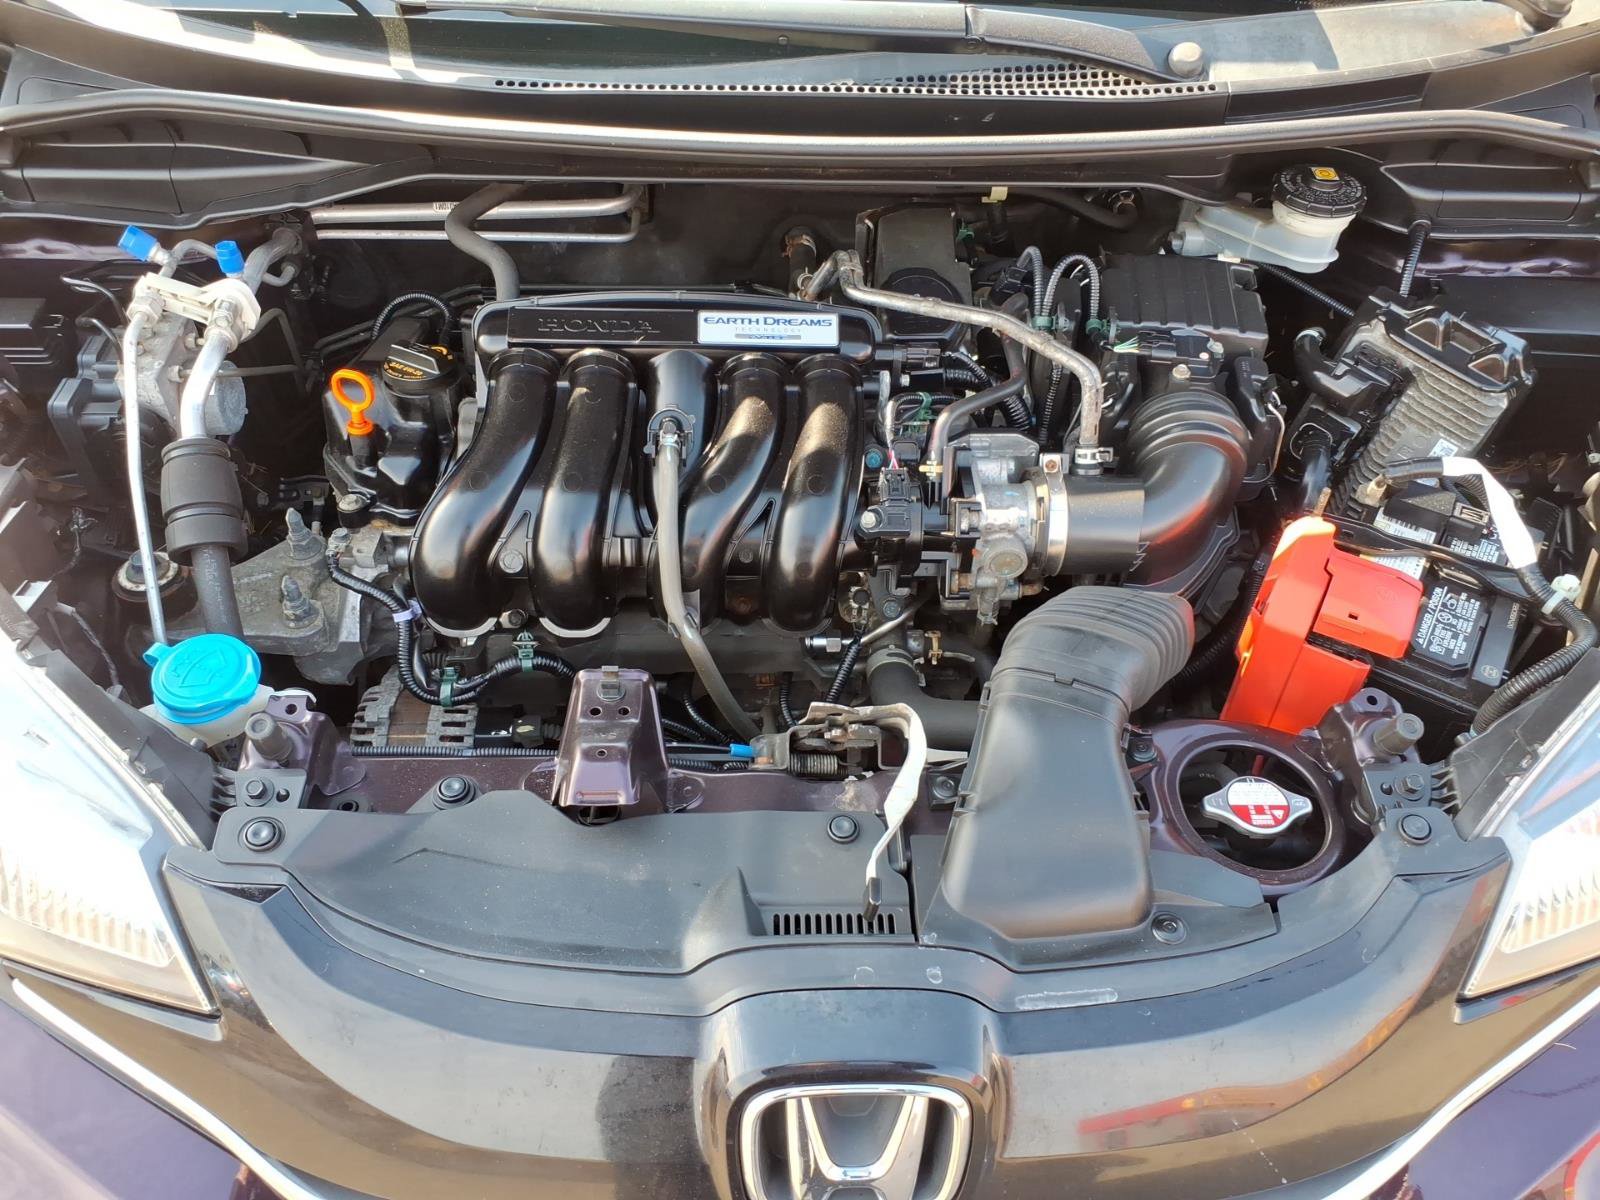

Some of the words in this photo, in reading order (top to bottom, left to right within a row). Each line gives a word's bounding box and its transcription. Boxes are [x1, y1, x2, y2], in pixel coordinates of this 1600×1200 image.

[538, 318, 661, 333] HONDA
[703, 316, 760, 326] EARTH
[763, 316, 833, 327] DREAMS
[1417, 613, 1432, 640] DANGER
[1428, 587, 1443, 609] POISON
